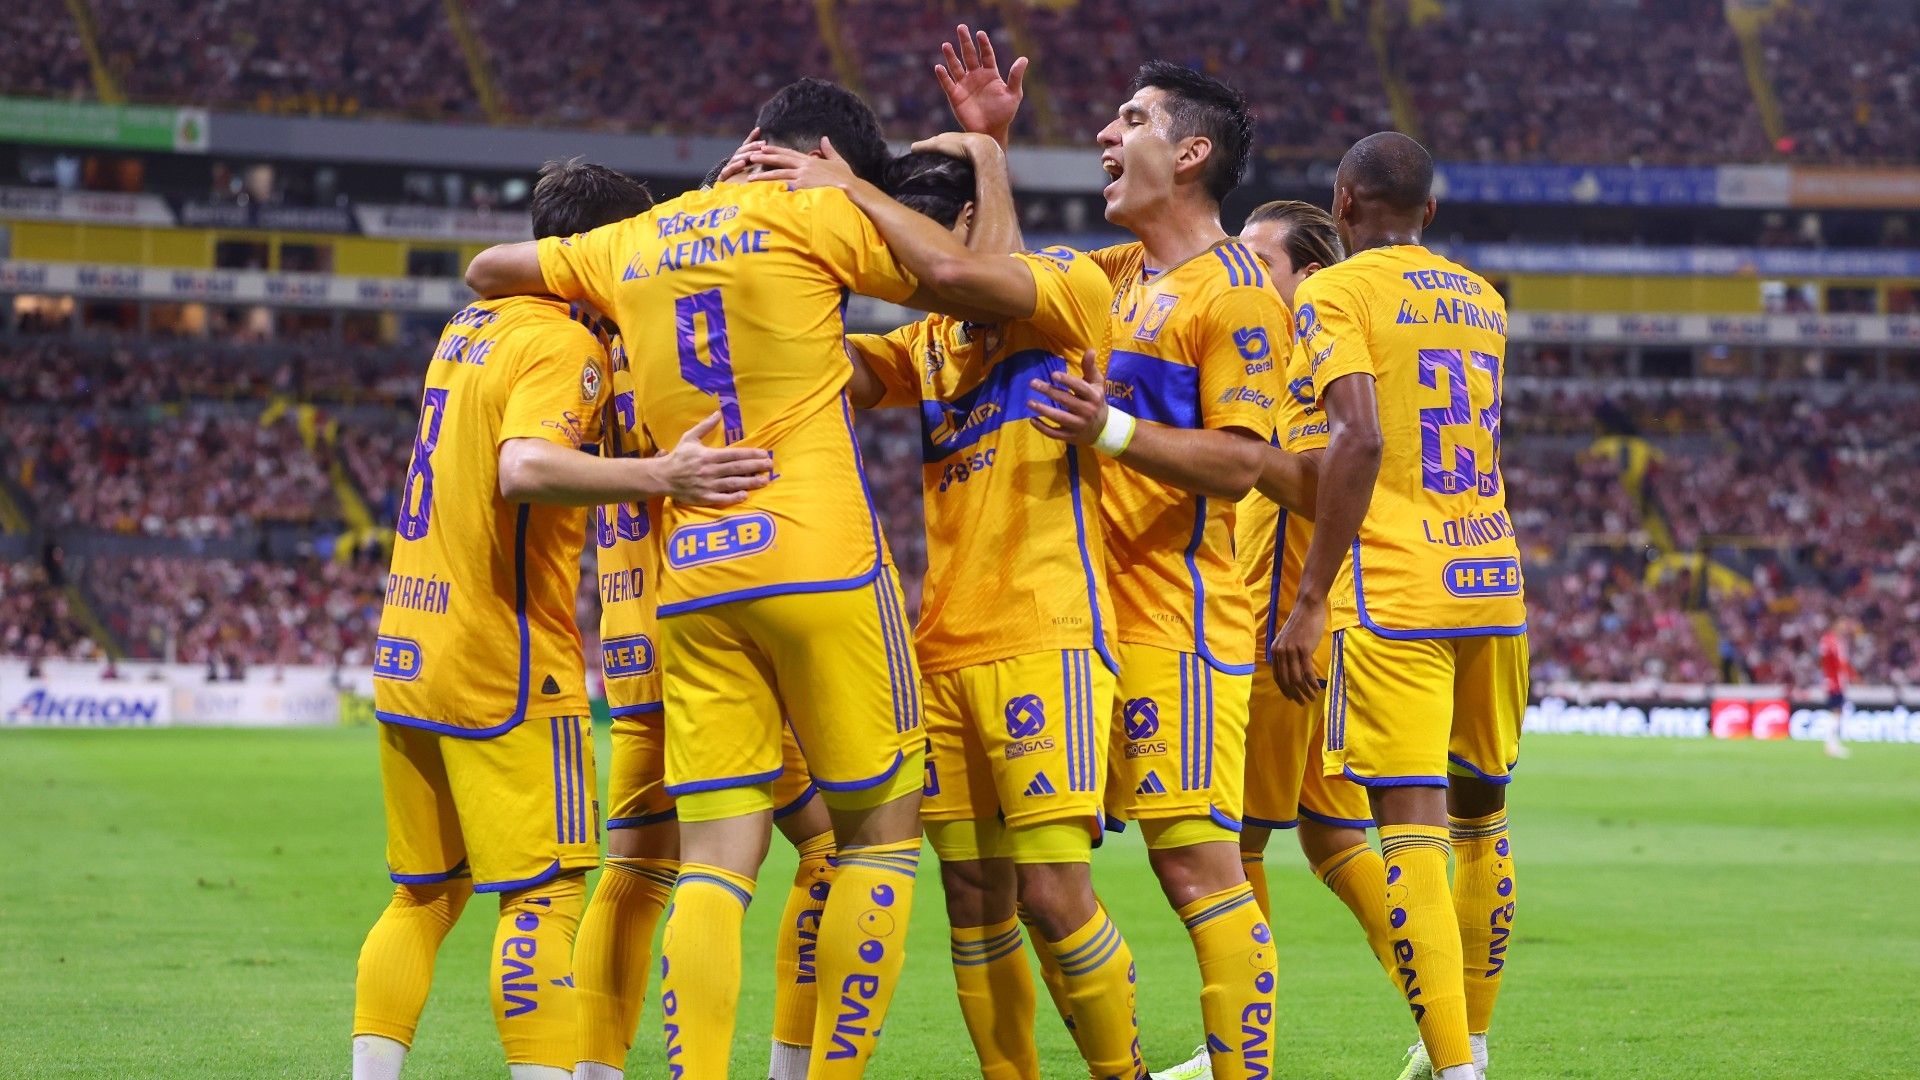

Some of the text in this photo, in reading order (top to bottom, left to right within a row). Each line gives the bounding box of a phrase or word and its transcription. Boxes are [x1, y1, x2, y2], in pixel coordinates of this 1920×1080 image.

[656, 230, 771, 276] AFIRME
[1403, 270, 1472, 296] TECATE
[437, 334, 496, 365] IRME
[675, 287, 744, 446] 9
[1245, 360, 1274, 376] Berel
[1236, 385, 1275, 409] telcel
[1418, 349, 1501, 497] 23
[396, 387, 450, 542] 8
[676, 522, 763, 560] H-E-B
[1455, 566, 1517, 588] H-E-B
[603, 645, 647, 669] H-E-B
[7, 687, 160, 722] AKRON
[502, 937, 538, 1019] viva
[825, 973, 880, 1060] viva
